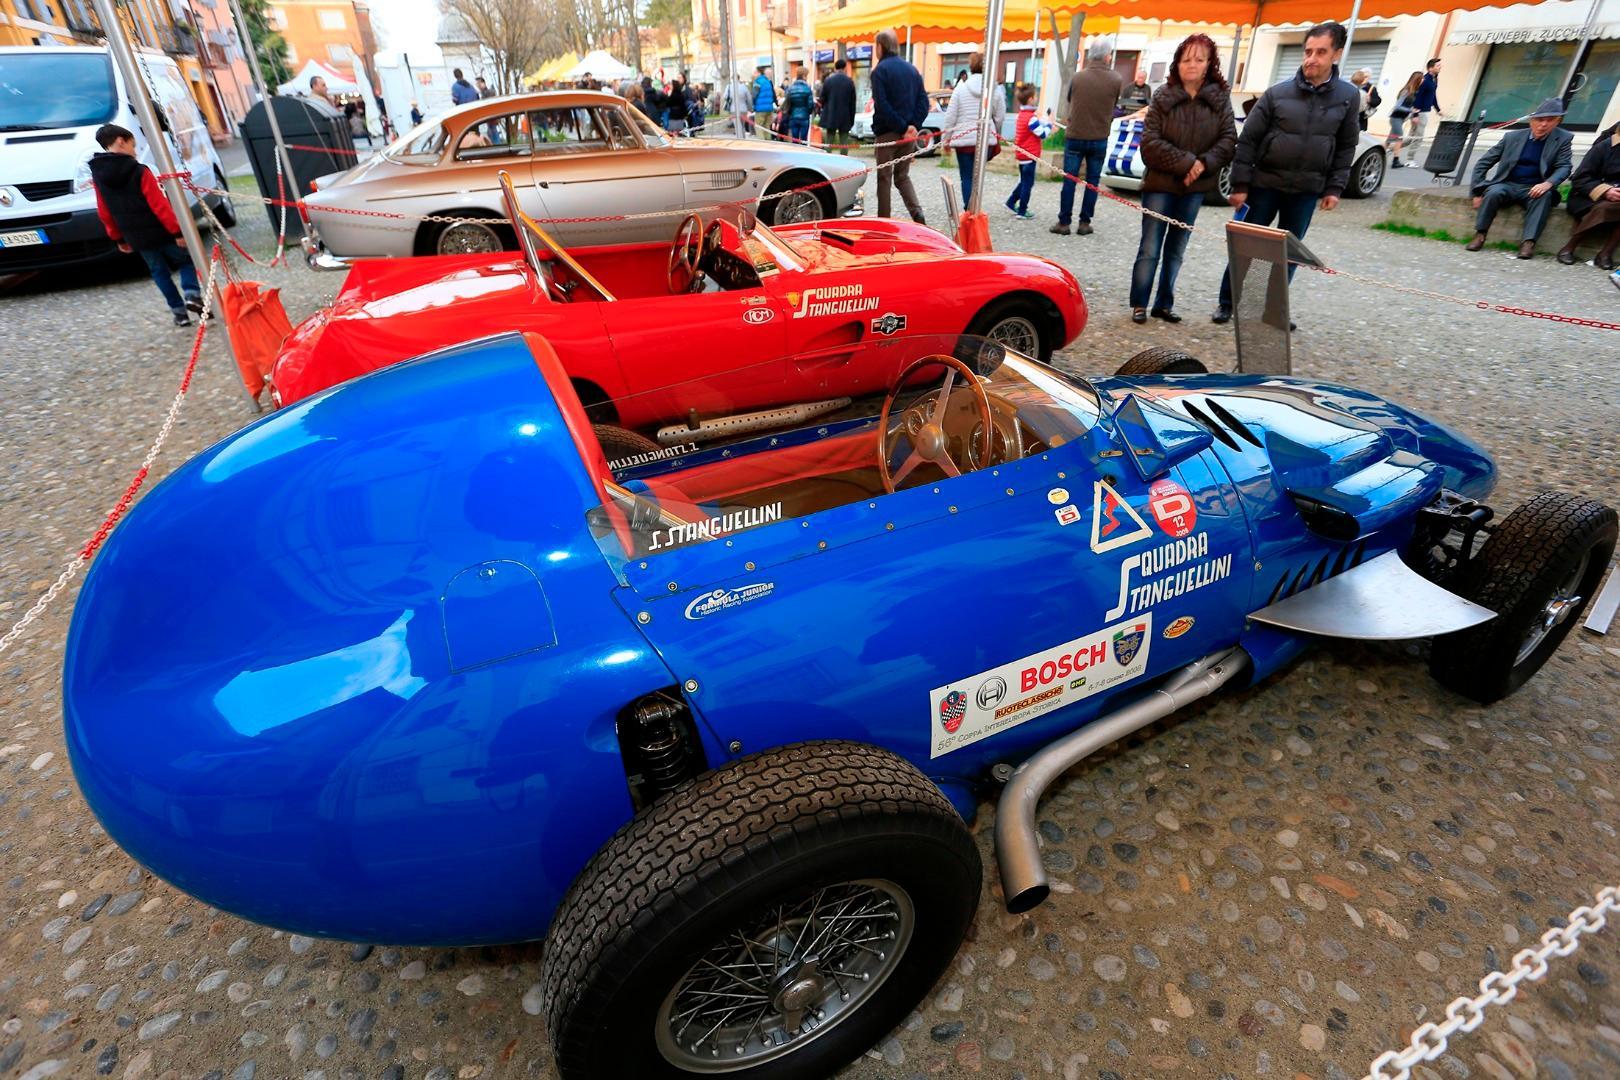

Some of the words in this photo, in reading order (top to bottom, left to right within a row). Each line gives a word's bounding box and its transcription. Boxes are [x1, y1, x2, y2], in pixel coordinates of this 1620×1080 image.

[1486, 30, 1531, 42] FUNEBRI
[1539, 26, 1606, 39] ZUCCHELI
[1152, 494, 1191, 521] D
[648, 530, 662, 551] S.
[664, 501, 782, 547] STANGUELLINI
[1172, 515, 1186, 528] 12
[695, 593, 740, 613] FORMULA
[740, 582, 774, 598] JUNIOR
[700, 605, 721, 616] Historic
[722, 599, 742, 609] Racing
[742, 589, 773, 603] Association
[1020, 640, 1107, 693] BOSCH
